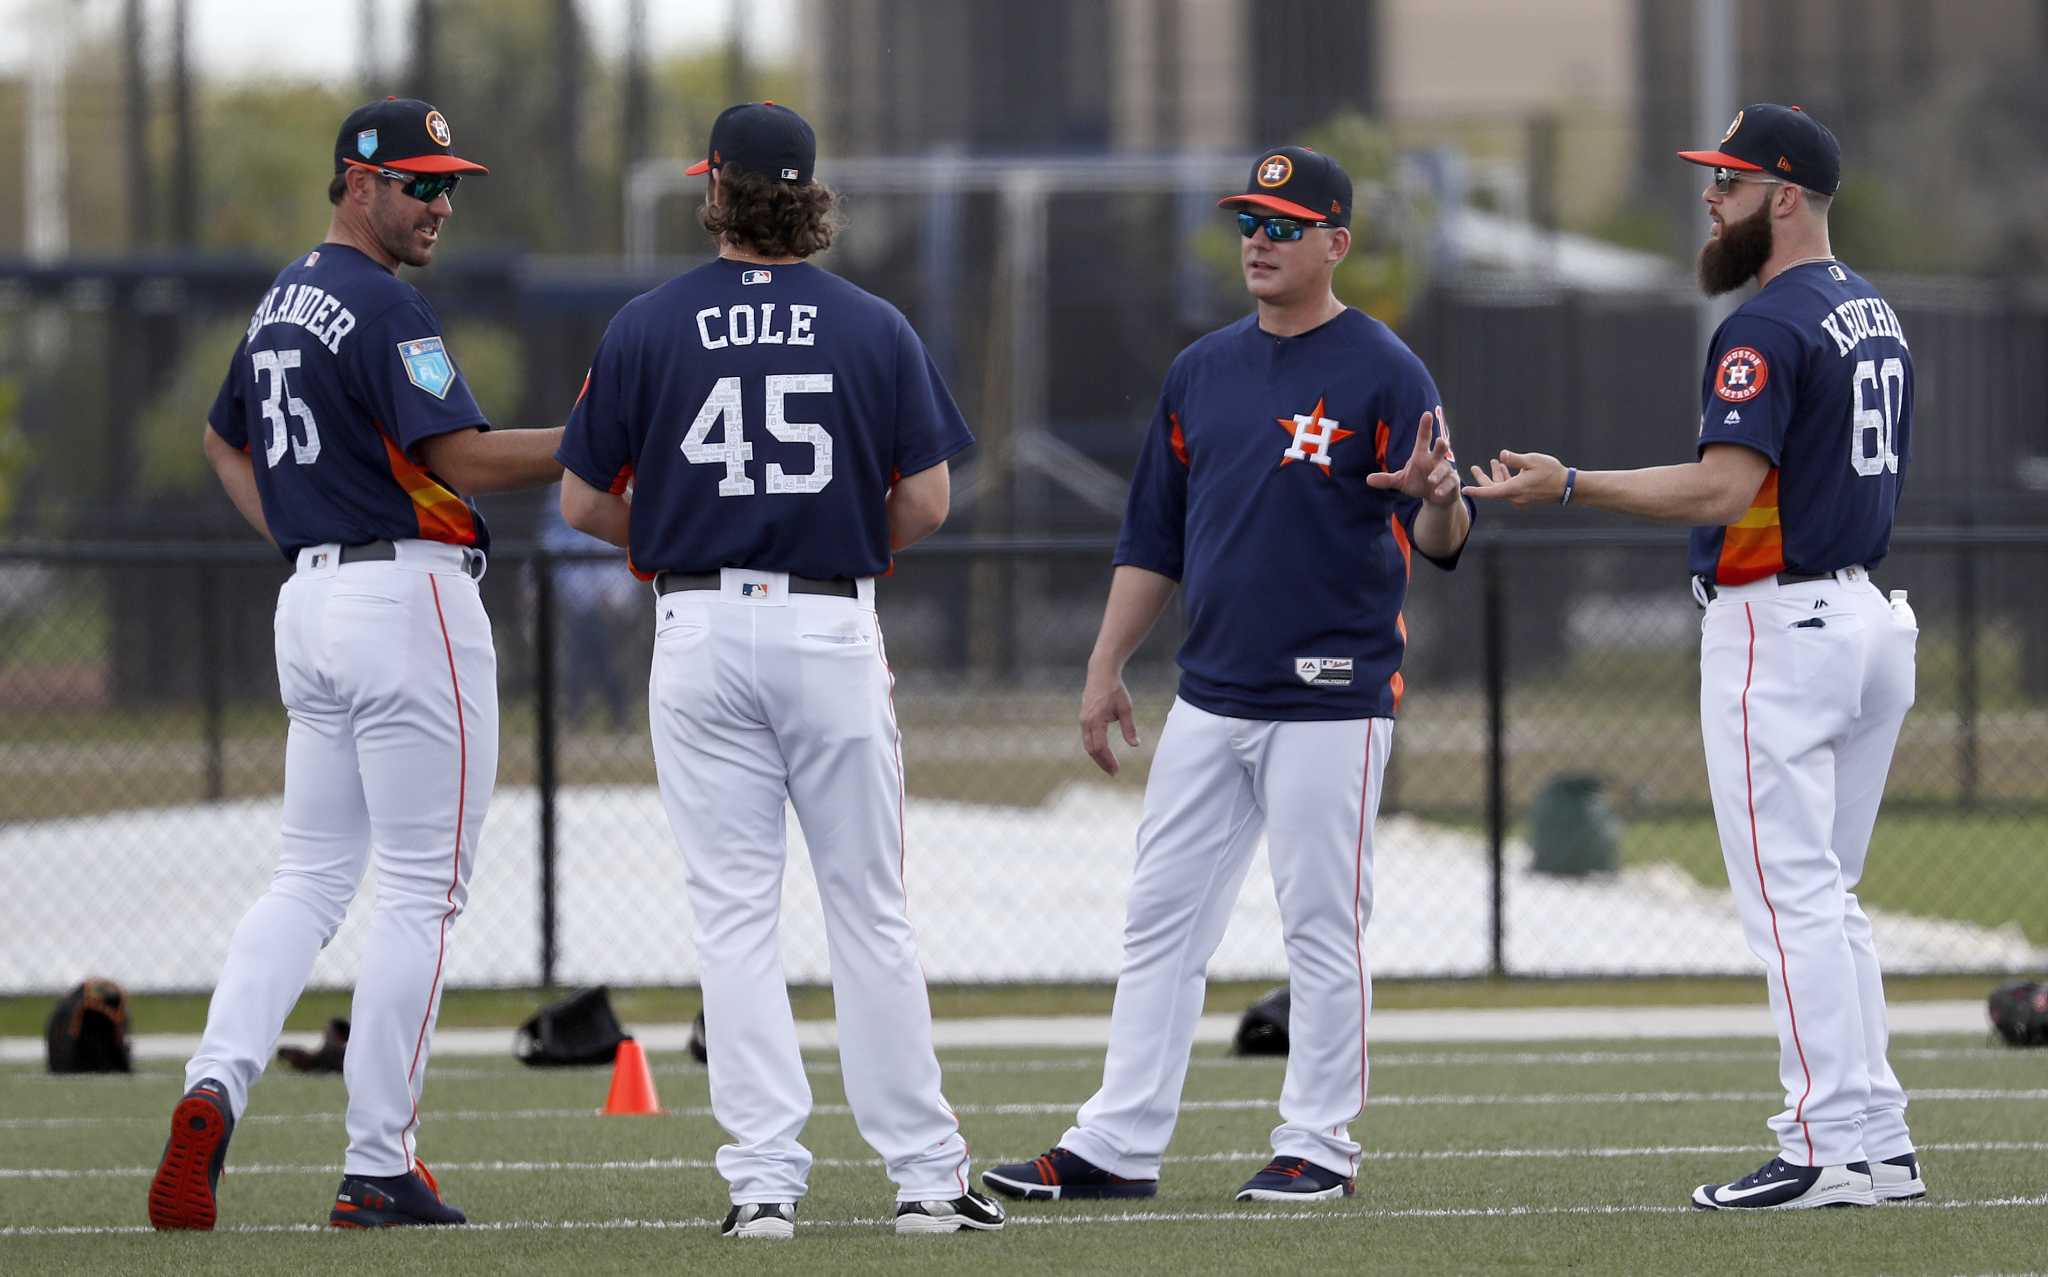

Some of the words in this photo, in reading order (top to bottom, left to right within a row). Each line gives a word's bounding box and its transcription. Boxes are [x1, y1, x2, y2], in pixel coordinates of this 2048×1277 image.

[1264, 163, 1284, 180] H
[696, 304, 818, 350] COLE
[1722, 350, 1761, 368] HOUSTON
[1728, 365, 1749, 385] H
[252, 349, 321, 469] 35
[1719, 385, 1757, 398] ASTROS
[680, 374, 833, 497] 45
[1284, 414, 1339, 466] H
[1851, 358, 1904, 476] 60
